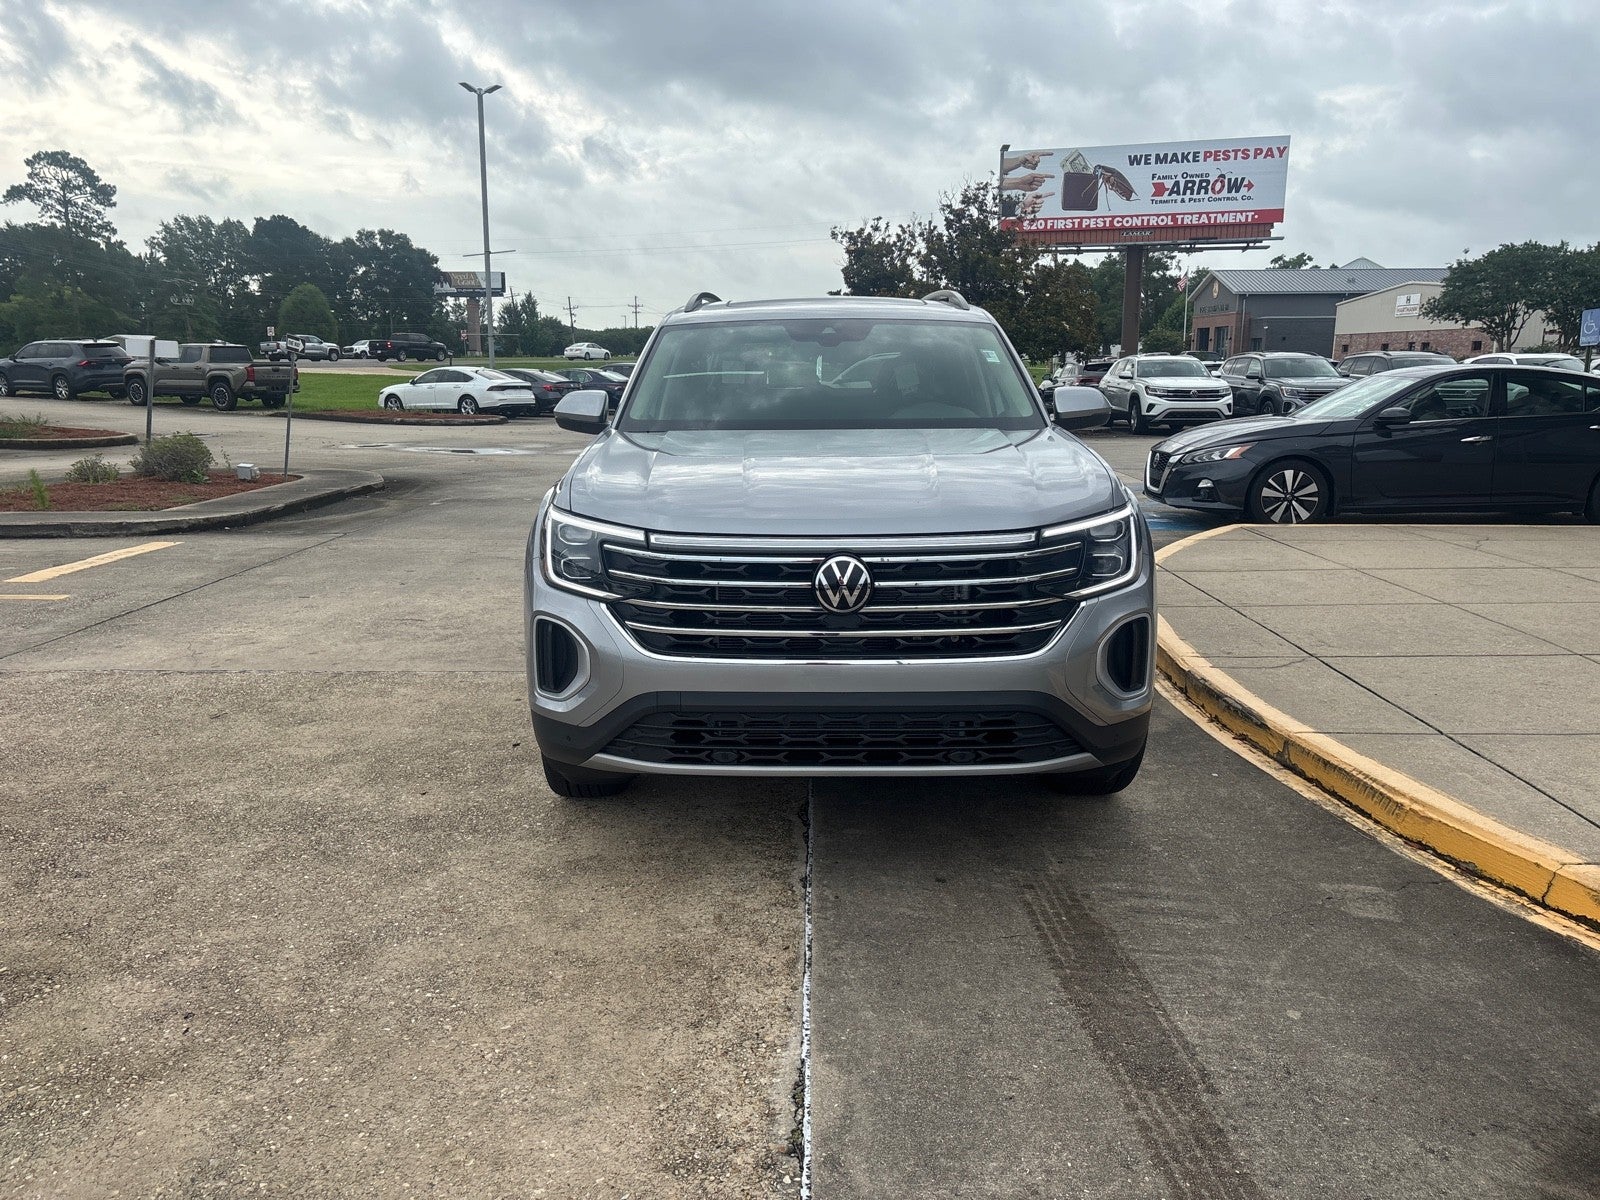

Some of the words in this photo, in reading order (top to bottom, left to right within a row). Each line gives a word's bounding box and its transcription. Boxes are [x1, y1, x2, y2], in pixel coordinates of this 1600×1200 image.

[1128, 153, 1152, 166] WE
[1154, 151, 1201, 165] MAKE
[1203, 148, 1251, 162] PESTS
[1253, 146, 1288, 160] PAY
[1151, 173, 1179, 181] FAMILY
[1181, 171, 1210, 179] OWNED
[1167, 177, 1246, 196] ARROW
[1207, 195, 1239, 203] CONTROL
[1047, 219, 1080, 230] FIRST
[1082, 217, 1112, 228] PEST
[1113, 215, 1173, 227] CONTROL
